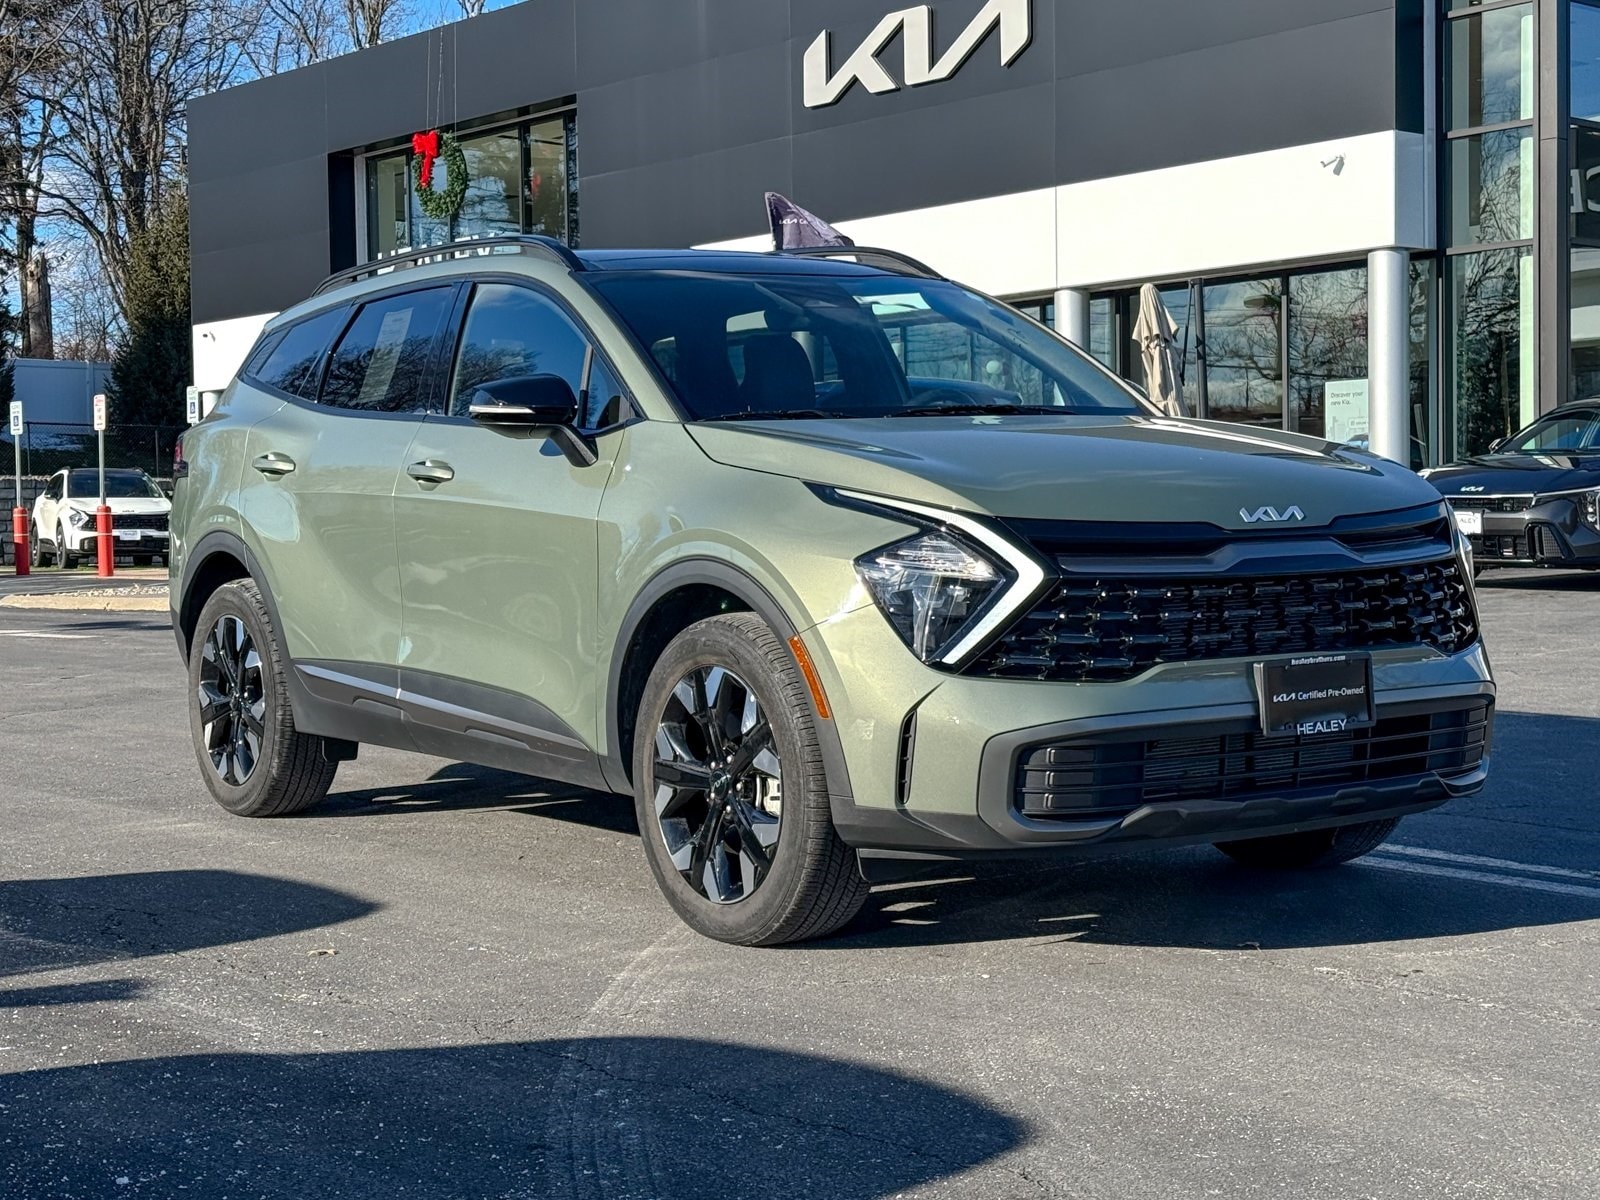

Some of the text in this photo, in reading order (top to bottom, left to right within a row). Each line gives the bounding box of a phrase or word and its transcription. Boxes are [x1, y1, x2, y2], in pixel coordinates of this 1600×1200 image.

[803, 0, 1031, 108] KIA
[1240, 505, 1305, 523] KIA
[1273, 686, 1365, 703] KIA Certified Pre-Owned
[1296, 718, 1347, 735] HEALEY
